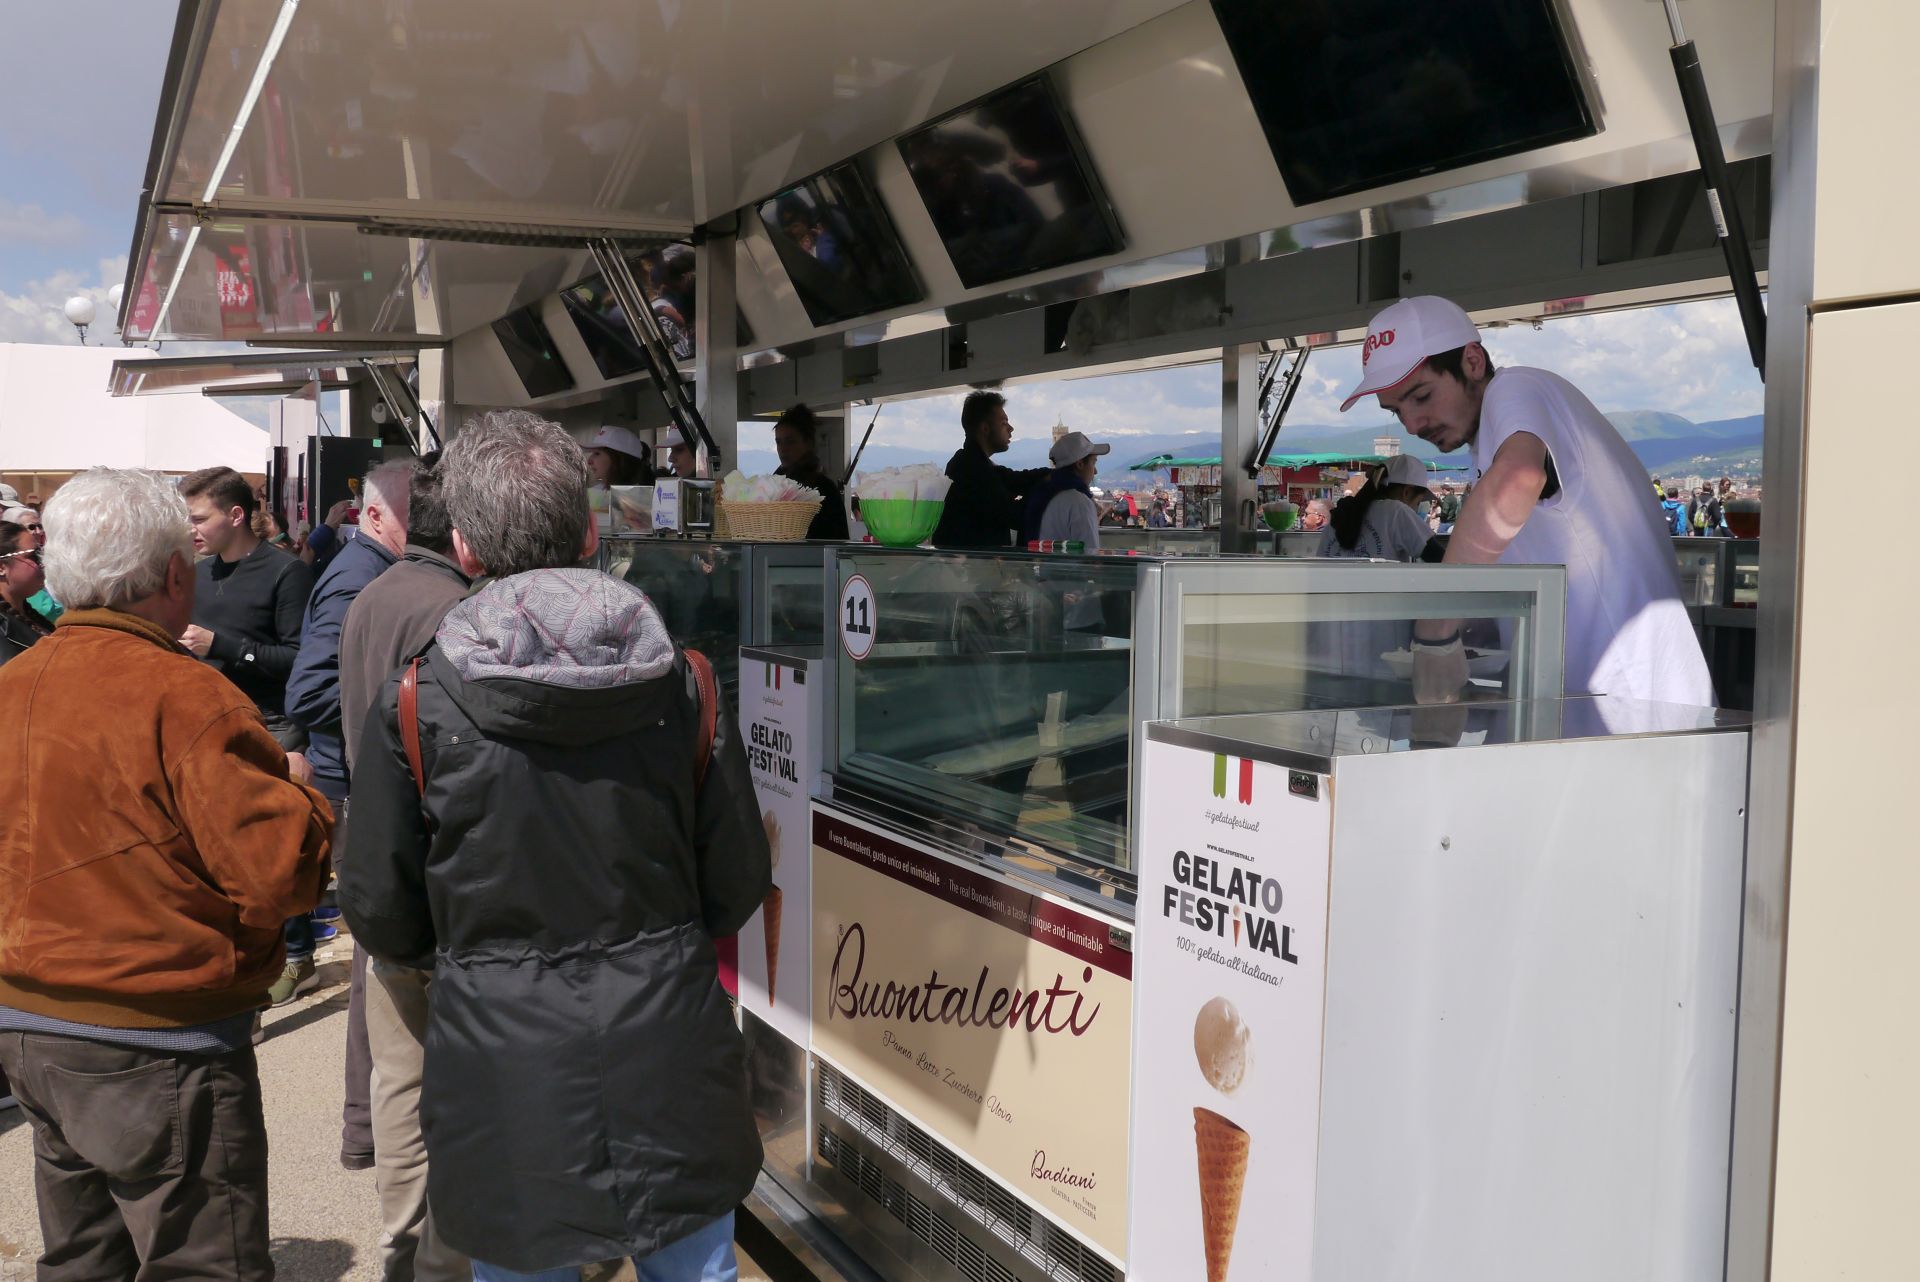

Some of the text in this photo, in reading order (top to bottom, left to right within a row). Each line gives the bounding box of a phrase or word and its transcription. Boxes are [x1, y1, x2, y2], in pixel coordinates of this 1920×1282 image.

[845, 595, 871, 634] 11
[751, 722, 792, 755] GELATO
[1290, 776, 1318, 791] ORION
[1205, 809, 1260, 832] #gelatofestival
[833, 834, 843, 845] vero
[843, 837, 872, 859] Buontalenti,
[872, 850, 887, 862] gusto
[887, 856, 902, 869] unico
[902, 861, 910, 873] ed
[910, 863, 940, 885] inimitabile
[949, 878, 959, 894] The
[959, 884, 970, 898] real
[971, 887, 1006, 916] Buontalenti,
[1007, 905, 1012, 916] a
[1012, 905, 1027, 923] taste
[1028, 913, 1051, 933] unique
[1052, 922, 1066, 939] and
[1066, 927, 1103, 954] inimitable
[1172, 850, 1283, 914] GELATO
[1176, 935, 1196, 954] 100%
[1197, 946, 1226, 964] gelato
[828, 921, 1101, 1037] Buontalenti
[1031, 1150, 1096, 1189] Badiani
